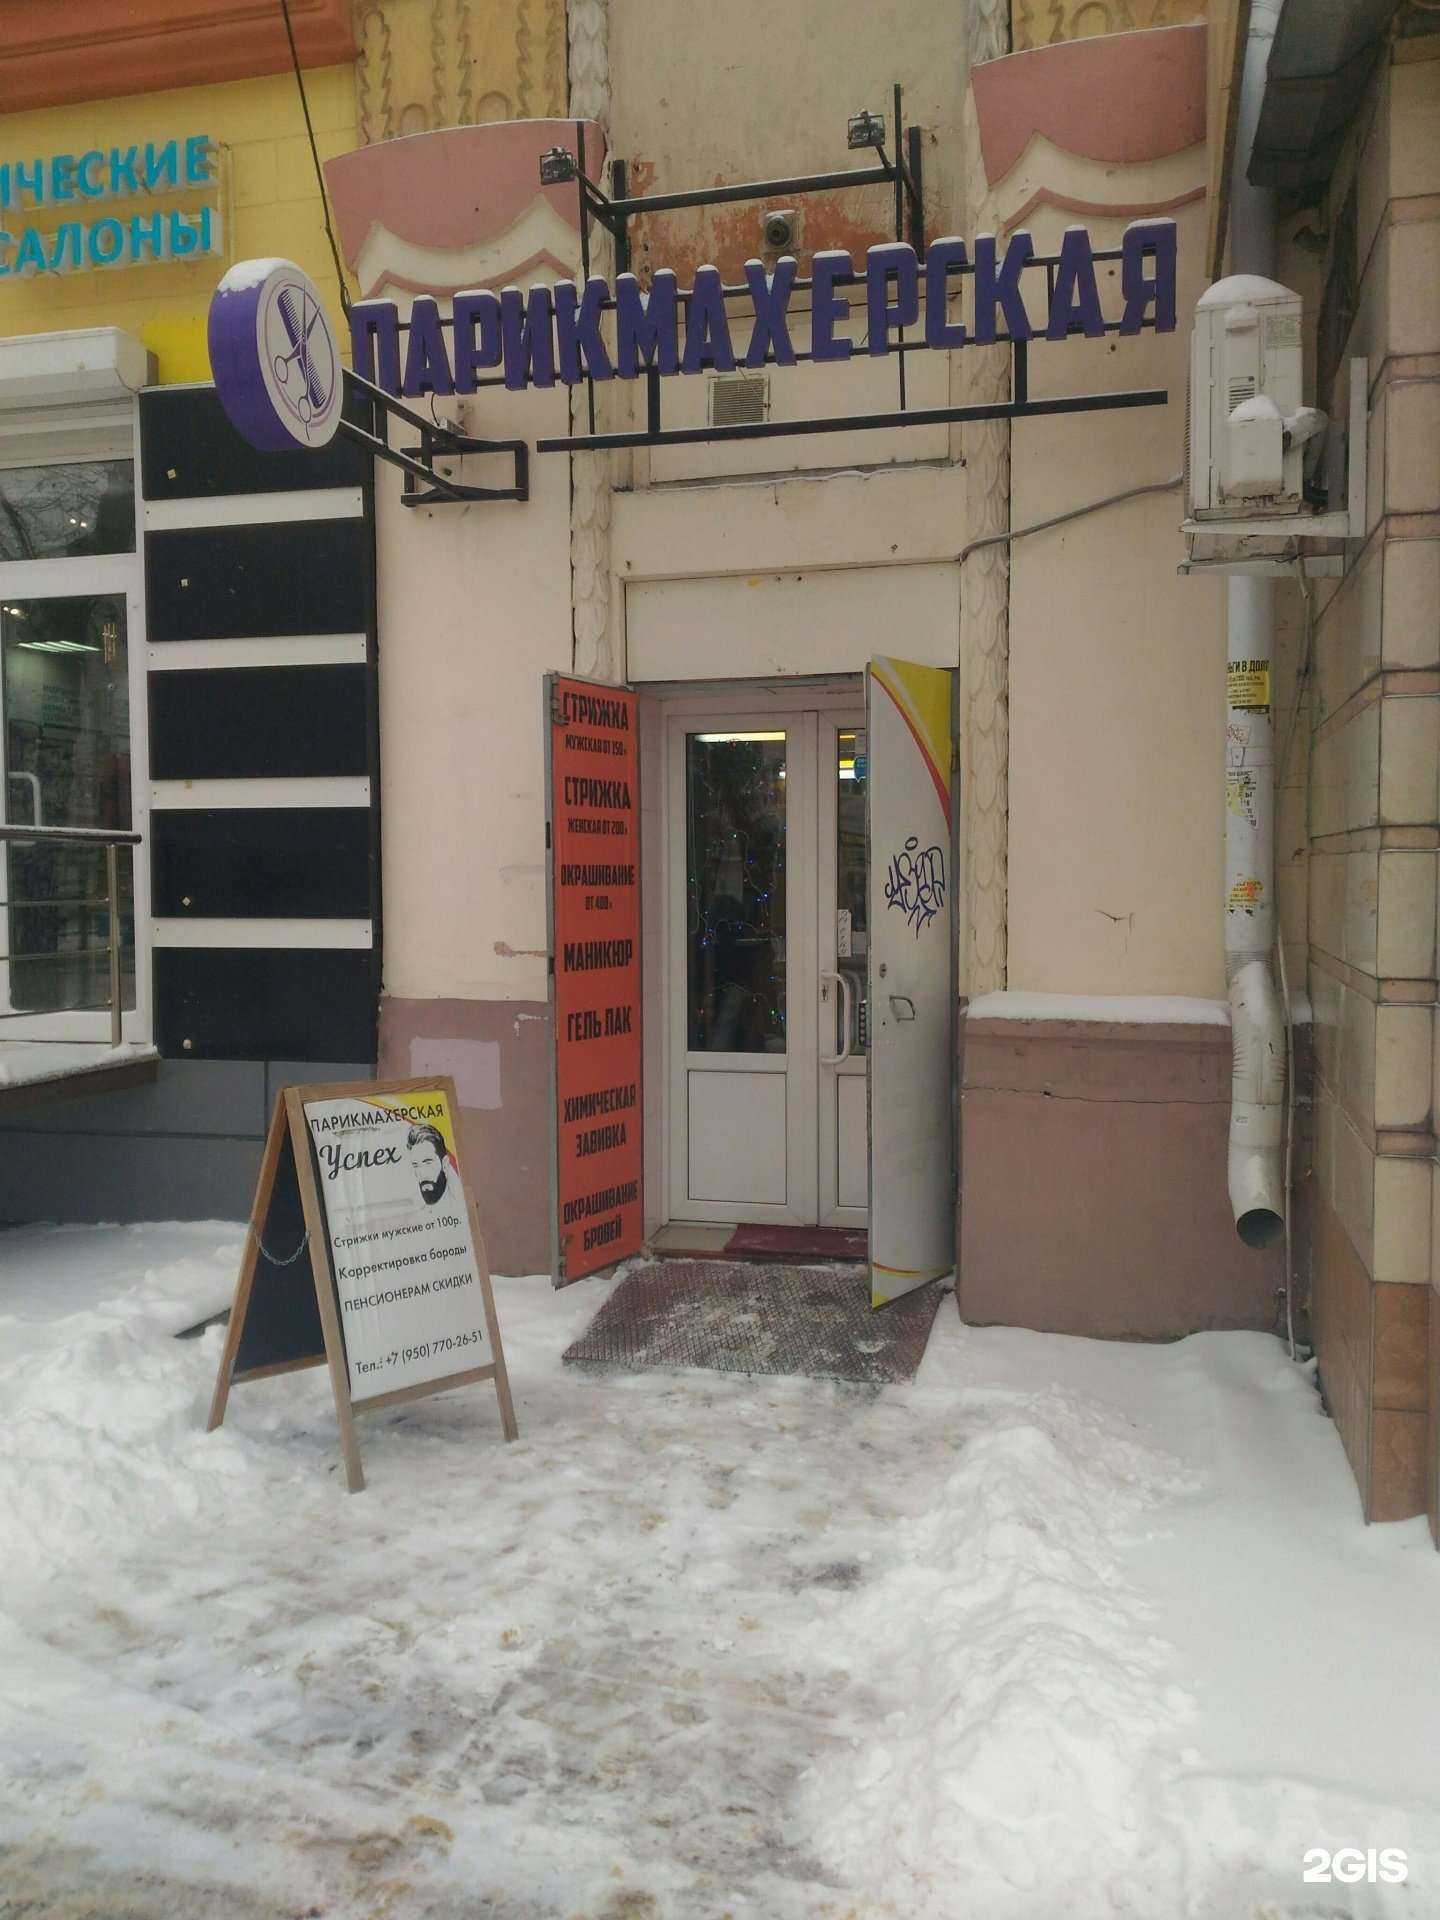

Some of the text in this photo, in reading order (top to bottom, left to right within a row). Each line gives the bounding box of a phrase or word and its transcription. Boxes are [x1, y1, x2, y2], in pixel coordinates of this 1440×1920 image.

[351, 219, 1177, 398] ПАРИКМАХЕРСКАЯ
[563, 692, 629, 731] СТРИЖКА
[566, 734, 601, 753] МУЖСКАЯ
[603, 740, 610, 754] ОТ
[565, 776, 631, 809] СТРИЖКА
[568, 817, 601, 833] ЖЕНСКАЯ
[602, 819, 610, 834] ОТ
[561, 864, 635, 886] ОКРАШИВАНИЕ
[585, 895, 594, 910] ОТ
[564, 939, 632, 973] МАНИКЮР
[568, 1005, 632, 1042] ГЕЛЬ ЛАК
[310, 1104, 444, 1133] ПАРИКМАХЕРСКАЯ
[564, 1084, 636, 1124] ХИМИЧЕСКАЯ
[576, 1122, 626, 1158] ЗАВИВКА
[319, 1146, 402, 1180] Успех
[564, 1180, 637, 1225] ОКРАШИВАНИЕ
[333, 1216, 462, 1249] Стрижки мужские от 100р.
[584, 1213, 622, 1252] БРОВЕЙ
[339, 1245, 467, 1279] Корректировка бороды
[344, 1273, 472, 1312] ПЕНСИОНЕРАМ СКИДКИ
[386, 1351, 398, 1365] +7
[402, 1344, 430, 1364] (950)
[432, 1330, 482, 1354] 770-26-51
